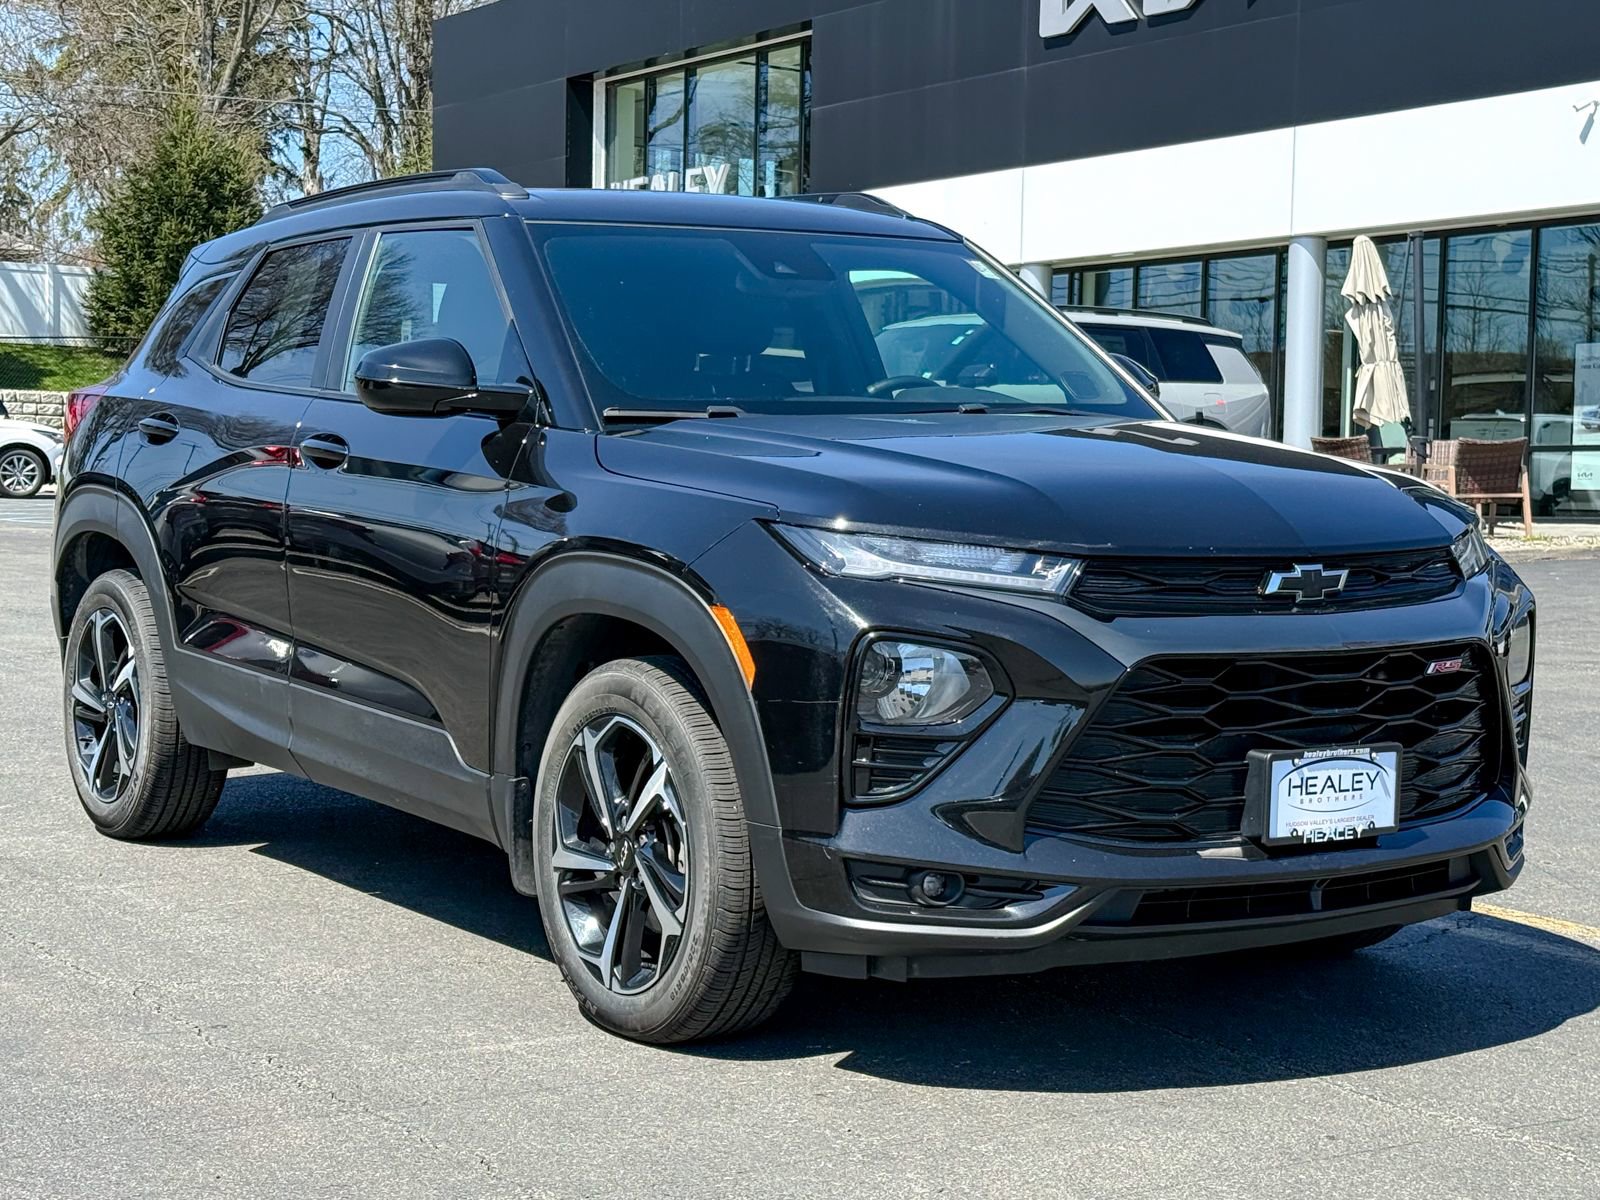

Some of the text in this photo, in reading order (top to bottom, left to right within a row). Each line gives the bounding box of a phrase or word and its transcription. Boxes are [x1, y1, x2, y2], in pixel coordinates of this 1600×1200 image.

[1288, 771, 1380, 797] HEALEY
[1300, 794, 1363, 804] BROTHERS
[1286, 820, 1309, 828] HUDSON
[1303, 825, 1363, 844] HEALEY
